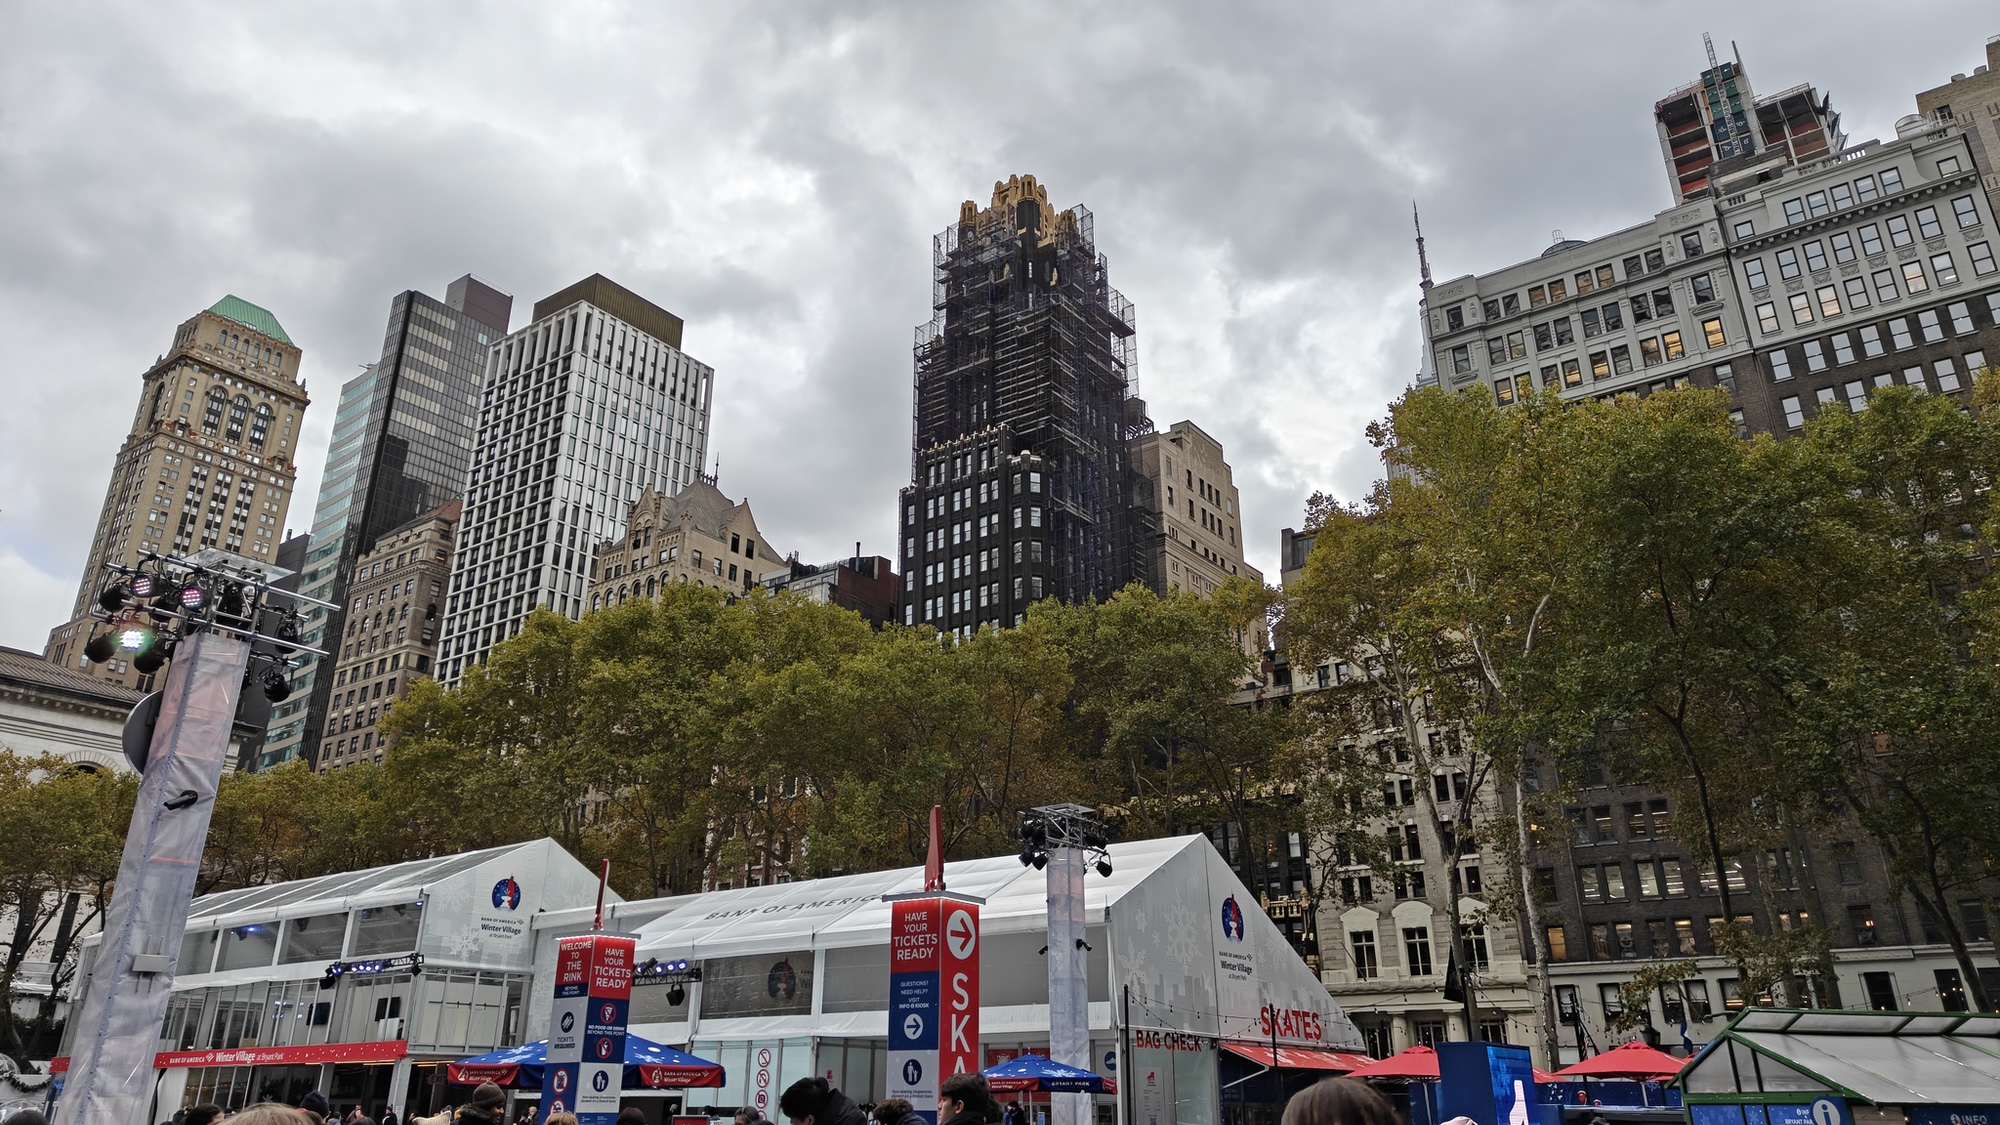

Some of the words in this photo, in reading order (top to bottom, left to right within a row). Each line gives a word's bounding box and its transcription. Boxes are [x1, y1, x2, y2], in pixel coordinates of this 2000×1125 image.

[704, 908, 758, 920] BANK
[761, 903, 791, 914] OF
[790, 894, 881, 912] AMERIC
[904, 911, 928, 922] HAVE
[481, 924, 502, 932] Winter
[502, 926, 522, 936] Village
[904, 922, 928, 933] YOUR
[561, 940, 593, 951] WELCOME
[893, 933, 938, 948] TICKETS
[605, 948, 625, 957] HAVE
[896, 947, 934, 961] READY
[567, 961, 582, 971] THE
[604, 957, 624, 966] YOUR
[594, 966, 631, 978] TICKETS
[1220, 960, 1237, 971] Winter
[1237, 963, 1253, 976] Village
[563, 972, 582, 982] RINK
[595, 977, 628, 989] READY
[1261, 1006, 1322, 1041] SKATES
[1136, 1030, 1161, 1049] BAG
[1164, 1032, 1202, 1052] CHECK
[215, 1052, 235, 1062] Winter
[235, 1051, 255, 1064] Village
[261, 1053, 275, 1062] Bryant
[275, 1052, 285, 1060] Park
[1961, 1115, 1988, 1125] INFO
